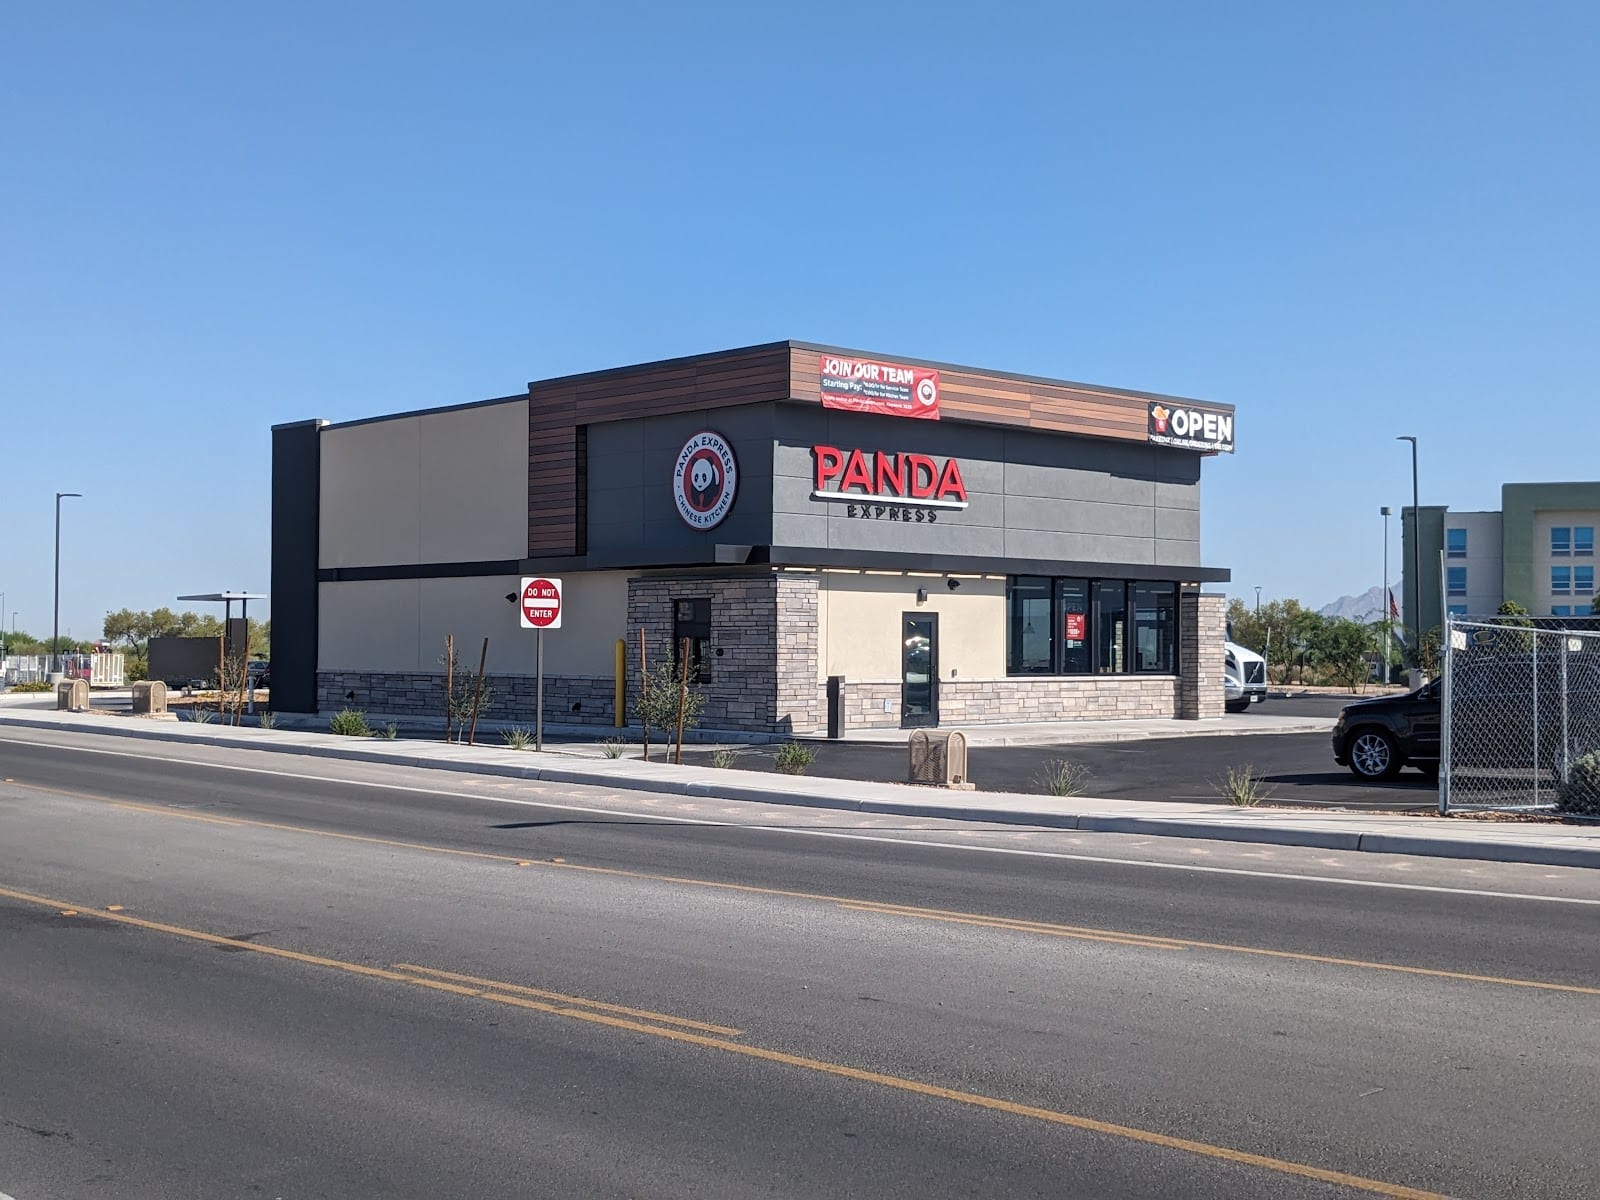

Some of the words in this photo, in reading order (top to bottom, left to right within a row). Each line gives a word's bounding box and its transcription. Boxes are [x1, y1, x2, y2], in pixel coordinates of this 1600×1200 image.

[823, 359, 852, 377] JOIN
[854, 363, 880, 381] OUR
[881, 367, 914, 385] TEAM
[823, 379, 849, 390] Starting
[1172, 409, 1232, 442] OPEN
[676, 440, 700, 477] PANDA
[701, 436, 733, 474] EXPRESS
[811, 445, 968, 502] PANDA
[678, 494, 702, 524] CHINESE
[704, 491, 731, 524] KITCHEN
[847, 504, 938, 523] EXPRESS
[527, 588, 538, 596] DO
[541, 588, 556, 597] NOT
[530, 609, 553, 618] ENTER
